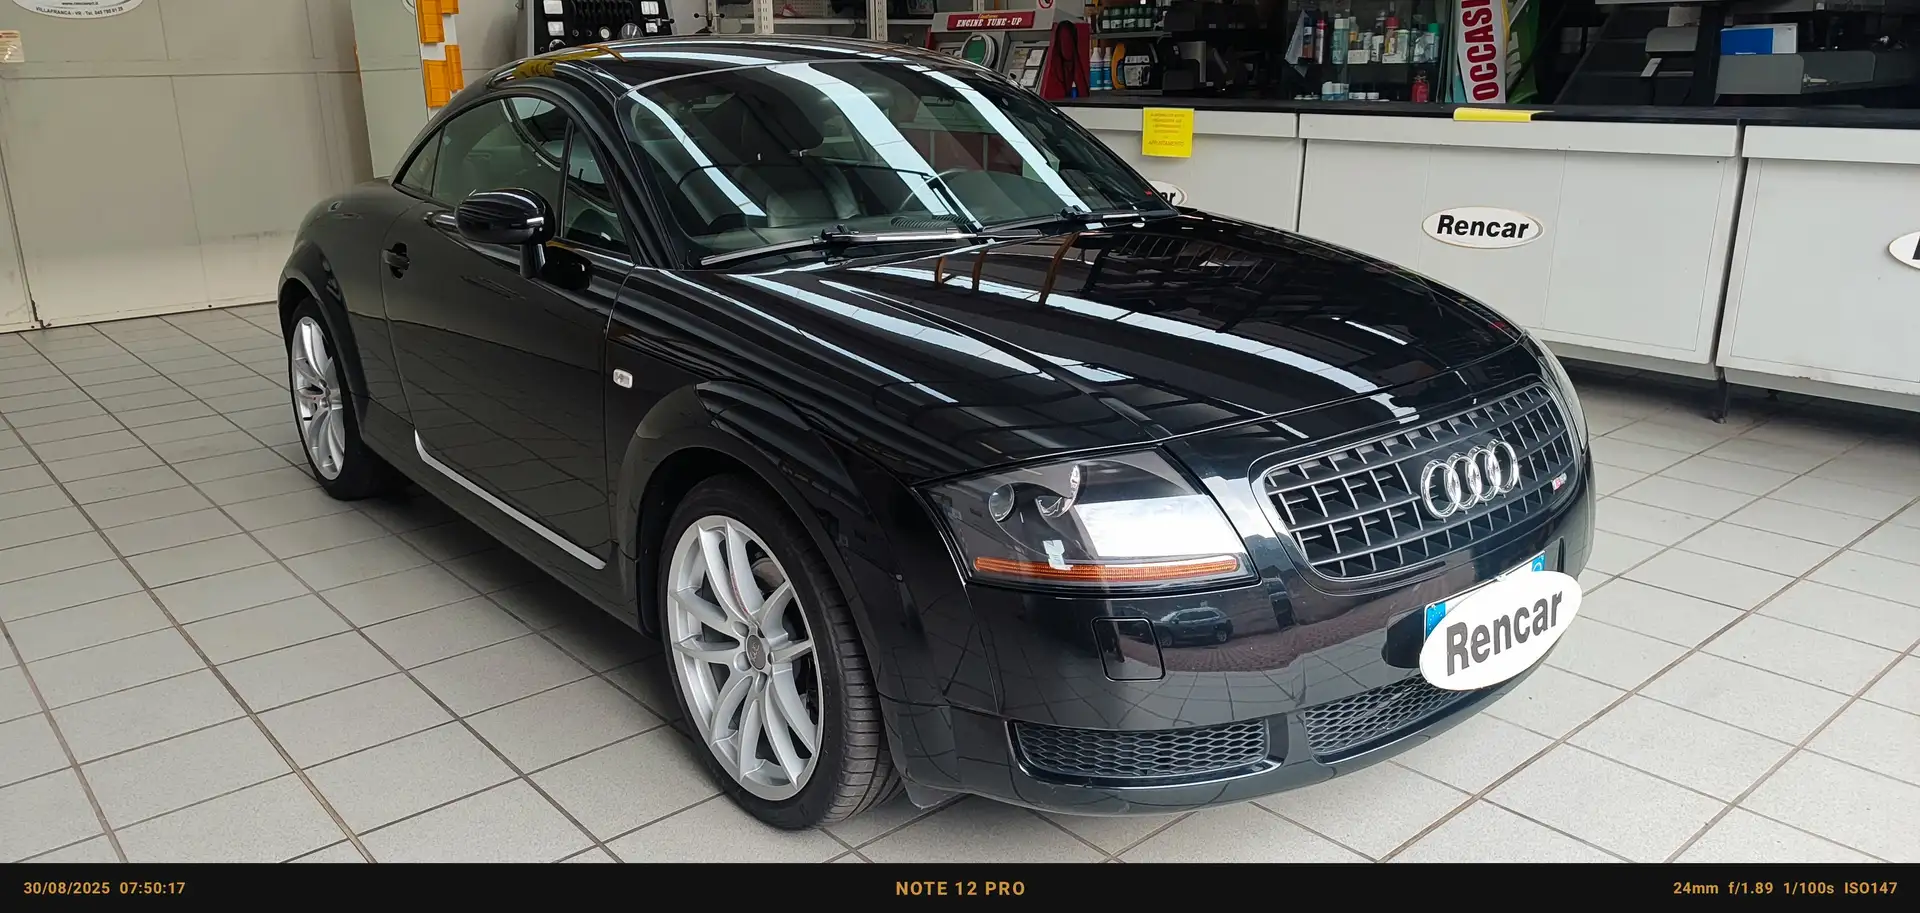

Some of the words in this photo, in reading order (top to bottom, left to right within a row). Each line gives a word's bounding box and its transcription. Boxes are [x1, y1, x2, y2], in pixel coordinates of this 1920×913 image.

[35, 6, 72, 16] VILLAFRANCA
[956, 19, 984, 28] ENGINE
[1437, 214, 1530, 239] Rencar
[1446, 590, 1563, 677] Rencar
